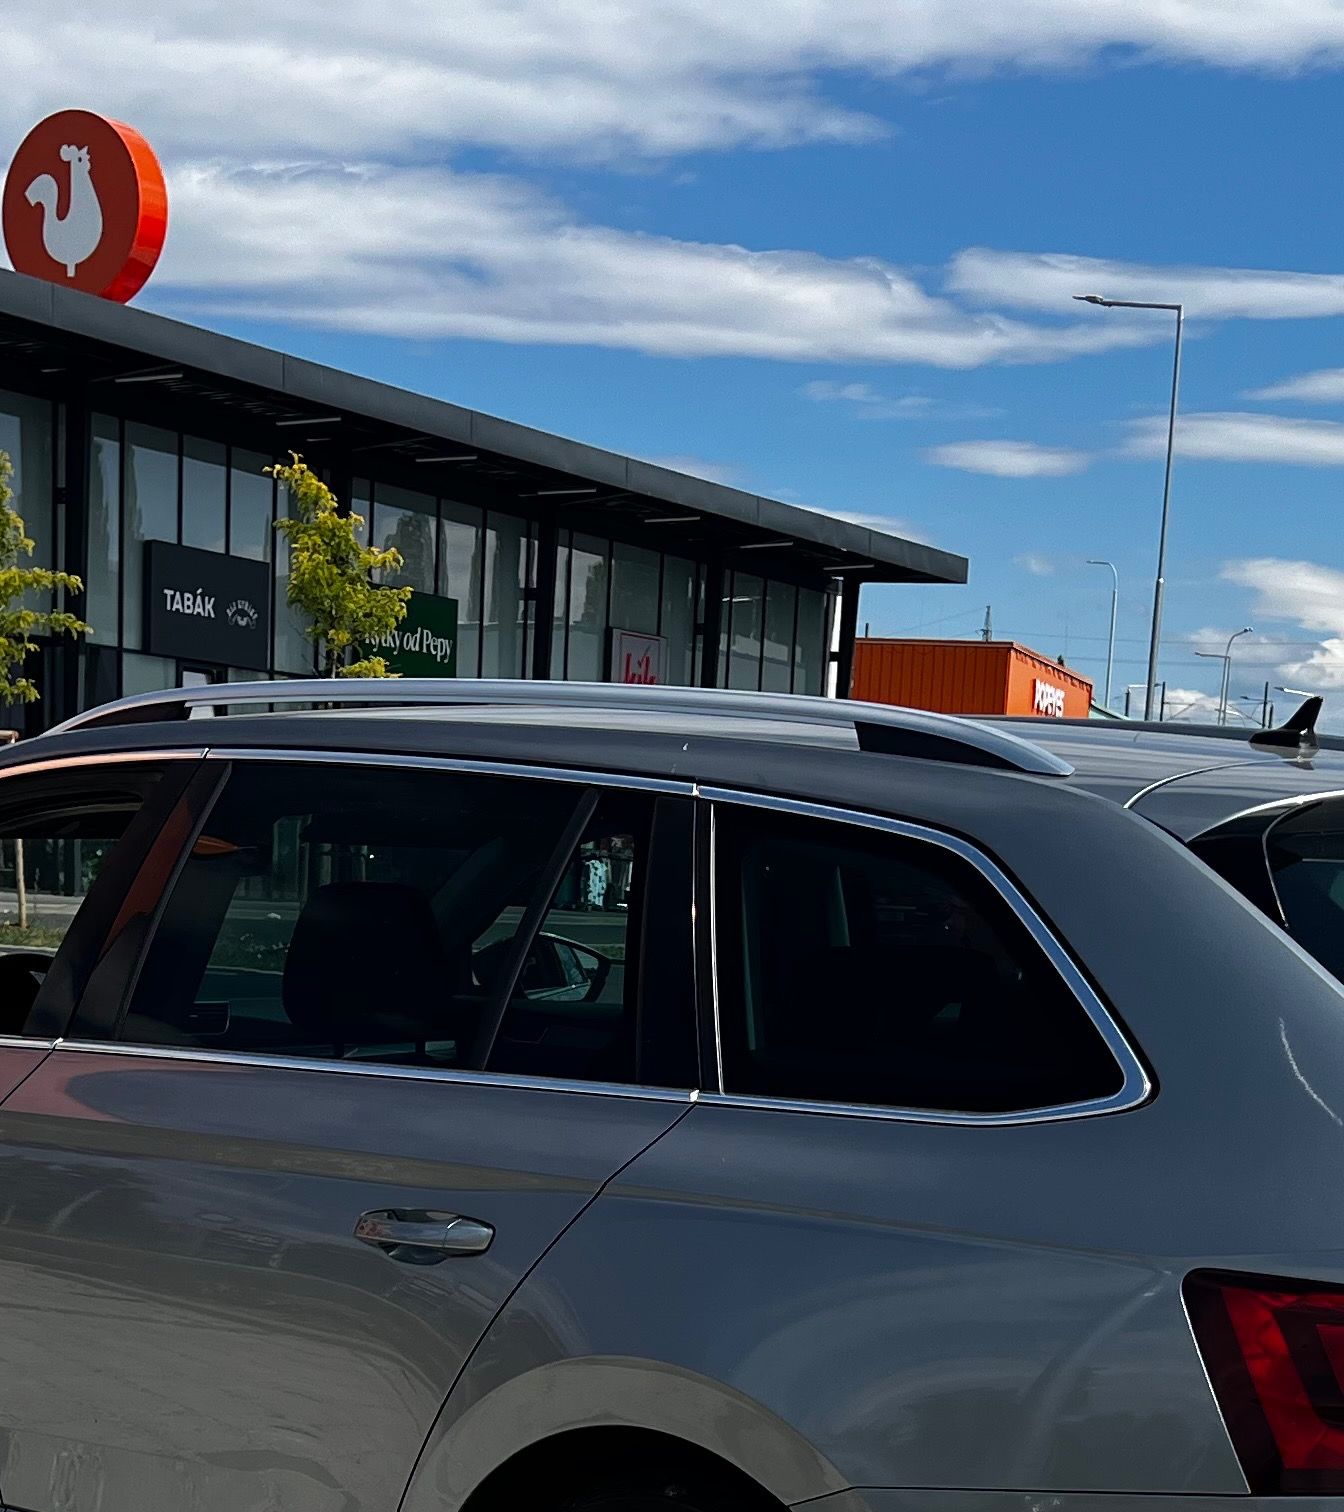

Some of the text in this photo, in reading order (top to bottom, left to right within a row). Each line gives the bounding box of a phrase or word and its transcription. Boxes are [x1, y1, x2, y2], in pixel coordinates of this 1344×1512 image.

[163, 588, 216, 619] TABÁK
[403, 626, 422, 652] od
[422, 629, 453, 664] Pepy
